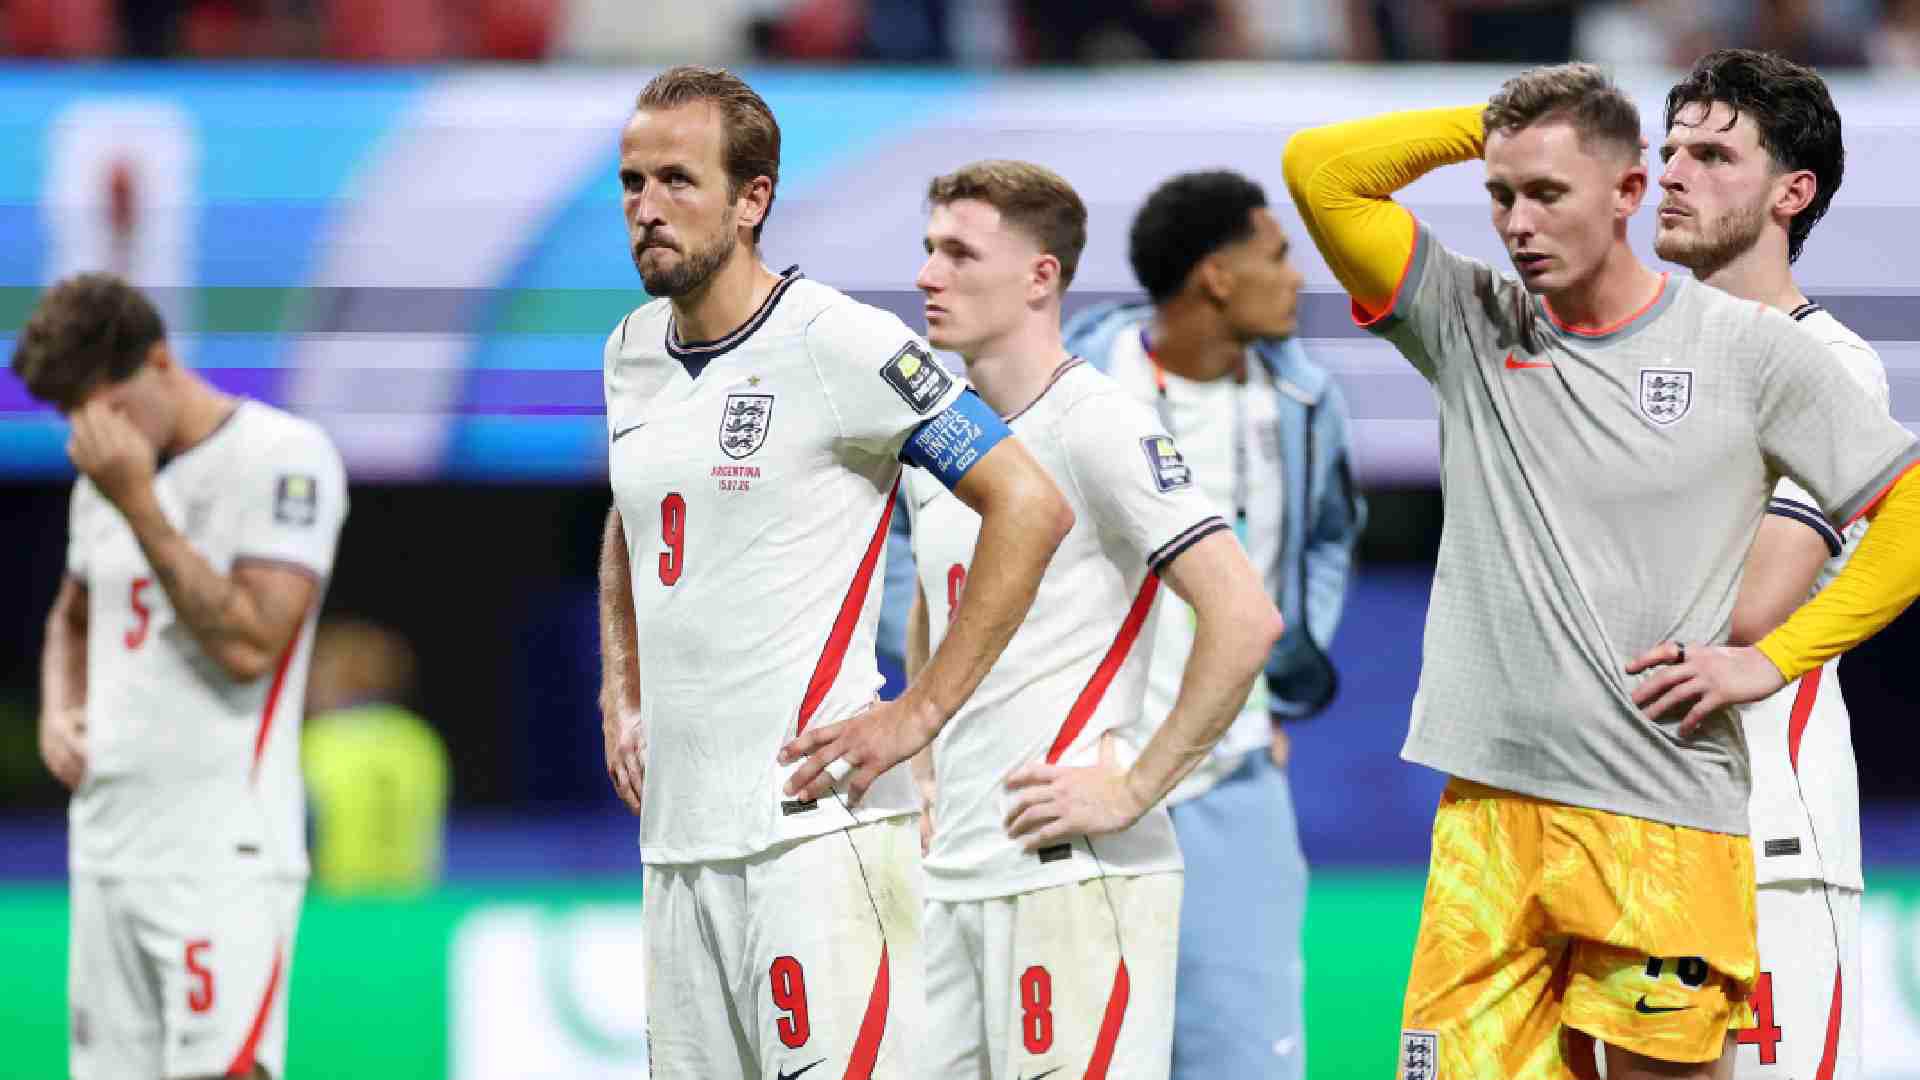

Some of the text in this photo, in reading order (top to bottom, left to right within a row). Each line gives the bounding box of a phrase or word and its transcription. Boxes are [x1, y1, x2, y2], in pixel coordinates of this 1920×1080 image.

[711, 465, 761, 478] ARGENTINA
[924, 413, 971, 458] UNITES
[659, 491, 686, 586] 9
[124, 578, 150, 651] 5
[185, 940, 214, 1015] 5
[769, 955, 811, 1050] 9
[1019, 965, 1054, 1055] 8
[1735, 971, 1781, 1065] 4
